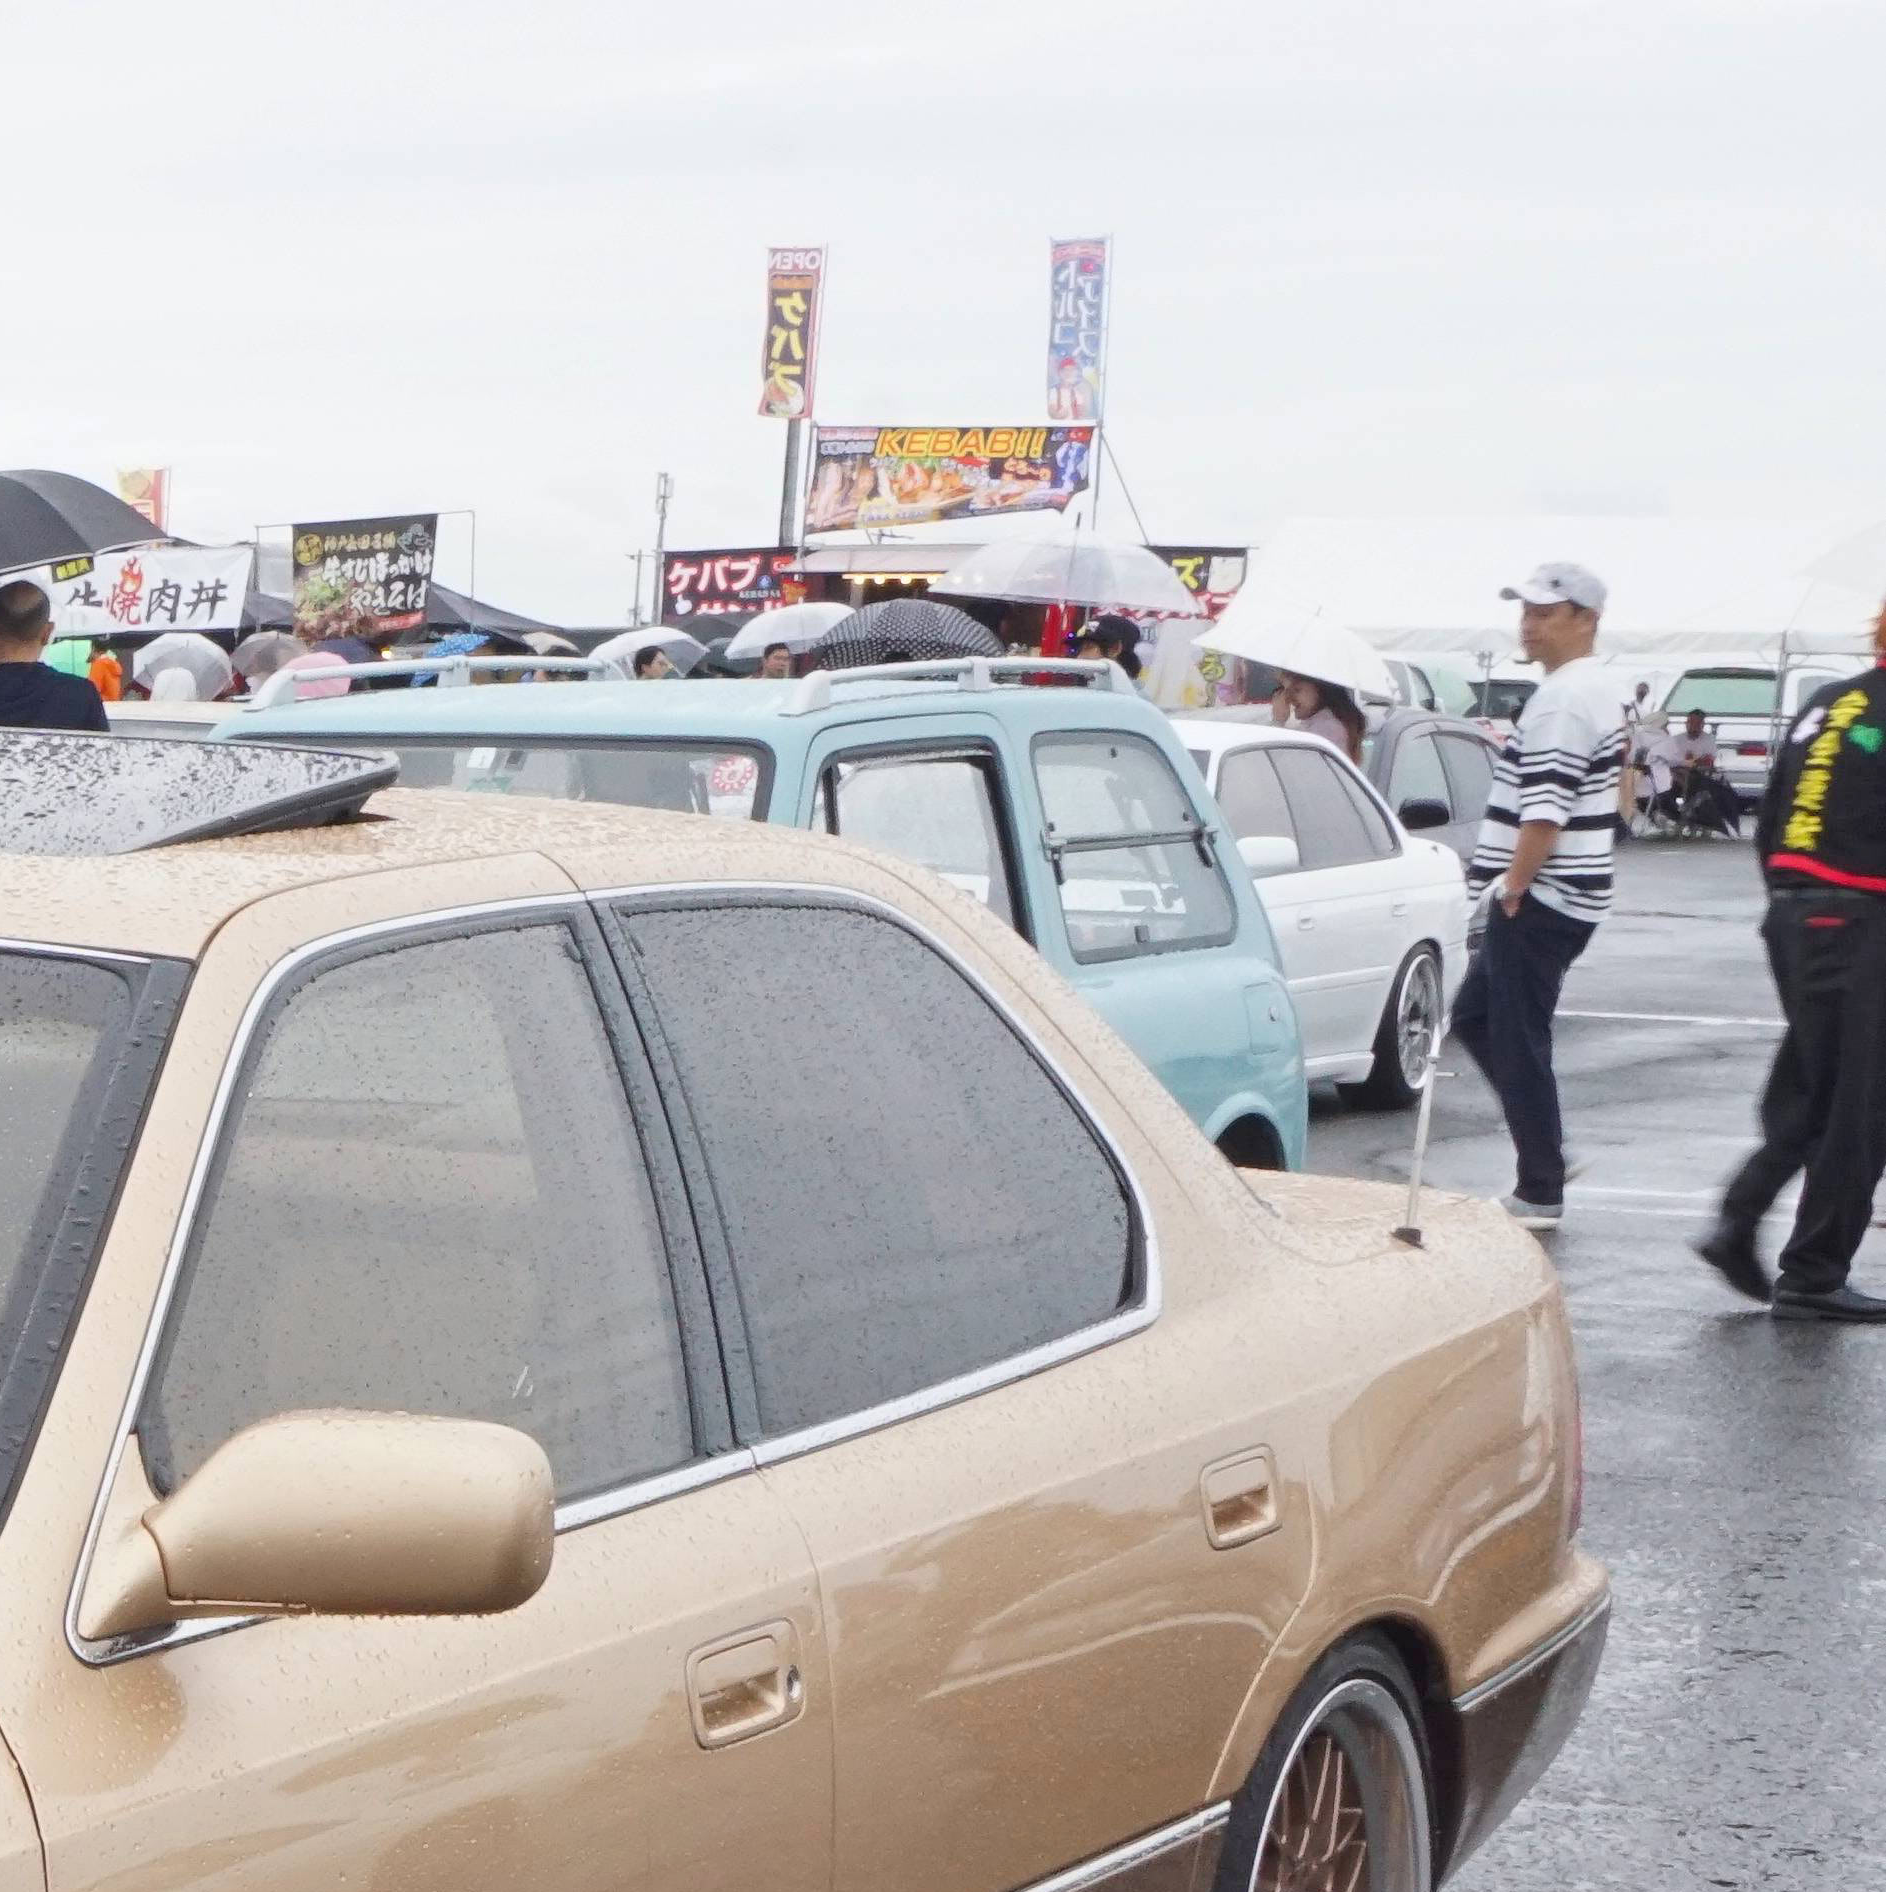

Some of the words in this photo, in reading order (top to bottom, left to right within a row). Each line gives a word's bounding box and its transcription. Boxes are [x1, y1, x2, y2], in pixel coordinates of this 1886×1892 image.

[874, 427, 1047, 459] KEBAB!!
[668, 554, 761, 594] ケバブ
